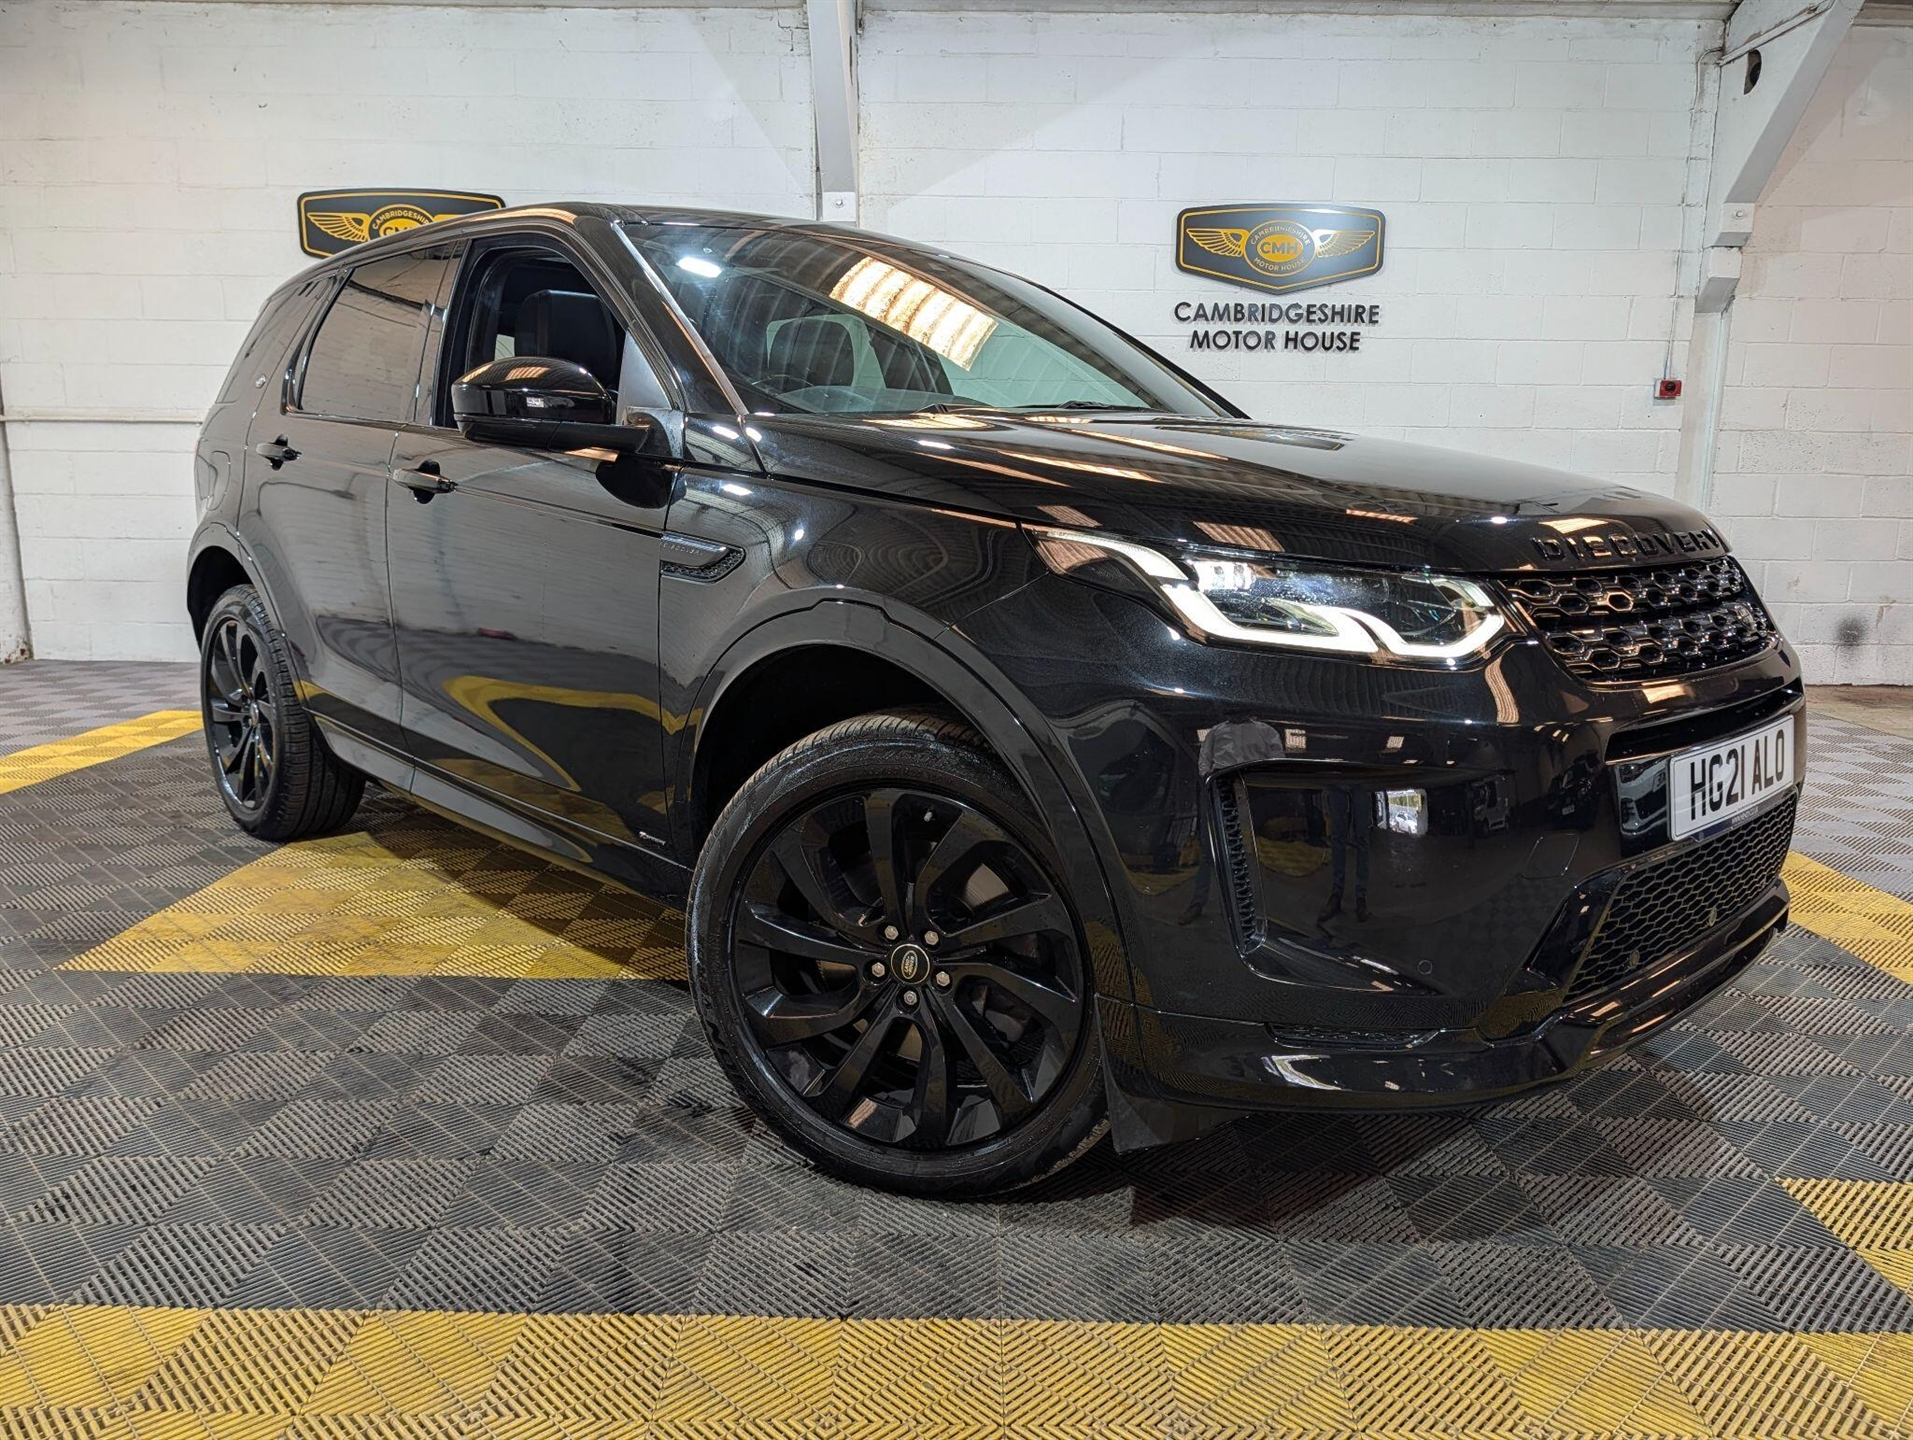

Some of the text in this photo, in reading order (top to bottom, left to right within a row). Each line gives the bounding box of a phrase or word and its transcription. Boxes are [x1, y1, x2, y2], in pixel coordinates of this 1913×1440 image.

[373, 210, 429, 229] CAMBRIDGESHIR
[383, 226, 412, 236] CM
[1250, 225, 1311, 246] CAMBRIDGESHIRE
[1259, 241, 1299, 254] CMH
[1253, 256, 1305, 271] MOTOR HOUSE
[1174, 301, 1380, 325] CAMBRIDGESHIRE
[1190, 330, 1361, 351] MOTOR HOUSE
[1531, 530, 1719, 560] DISCOVERY
[1690, 729, 1785, 821] HG21 ALO
